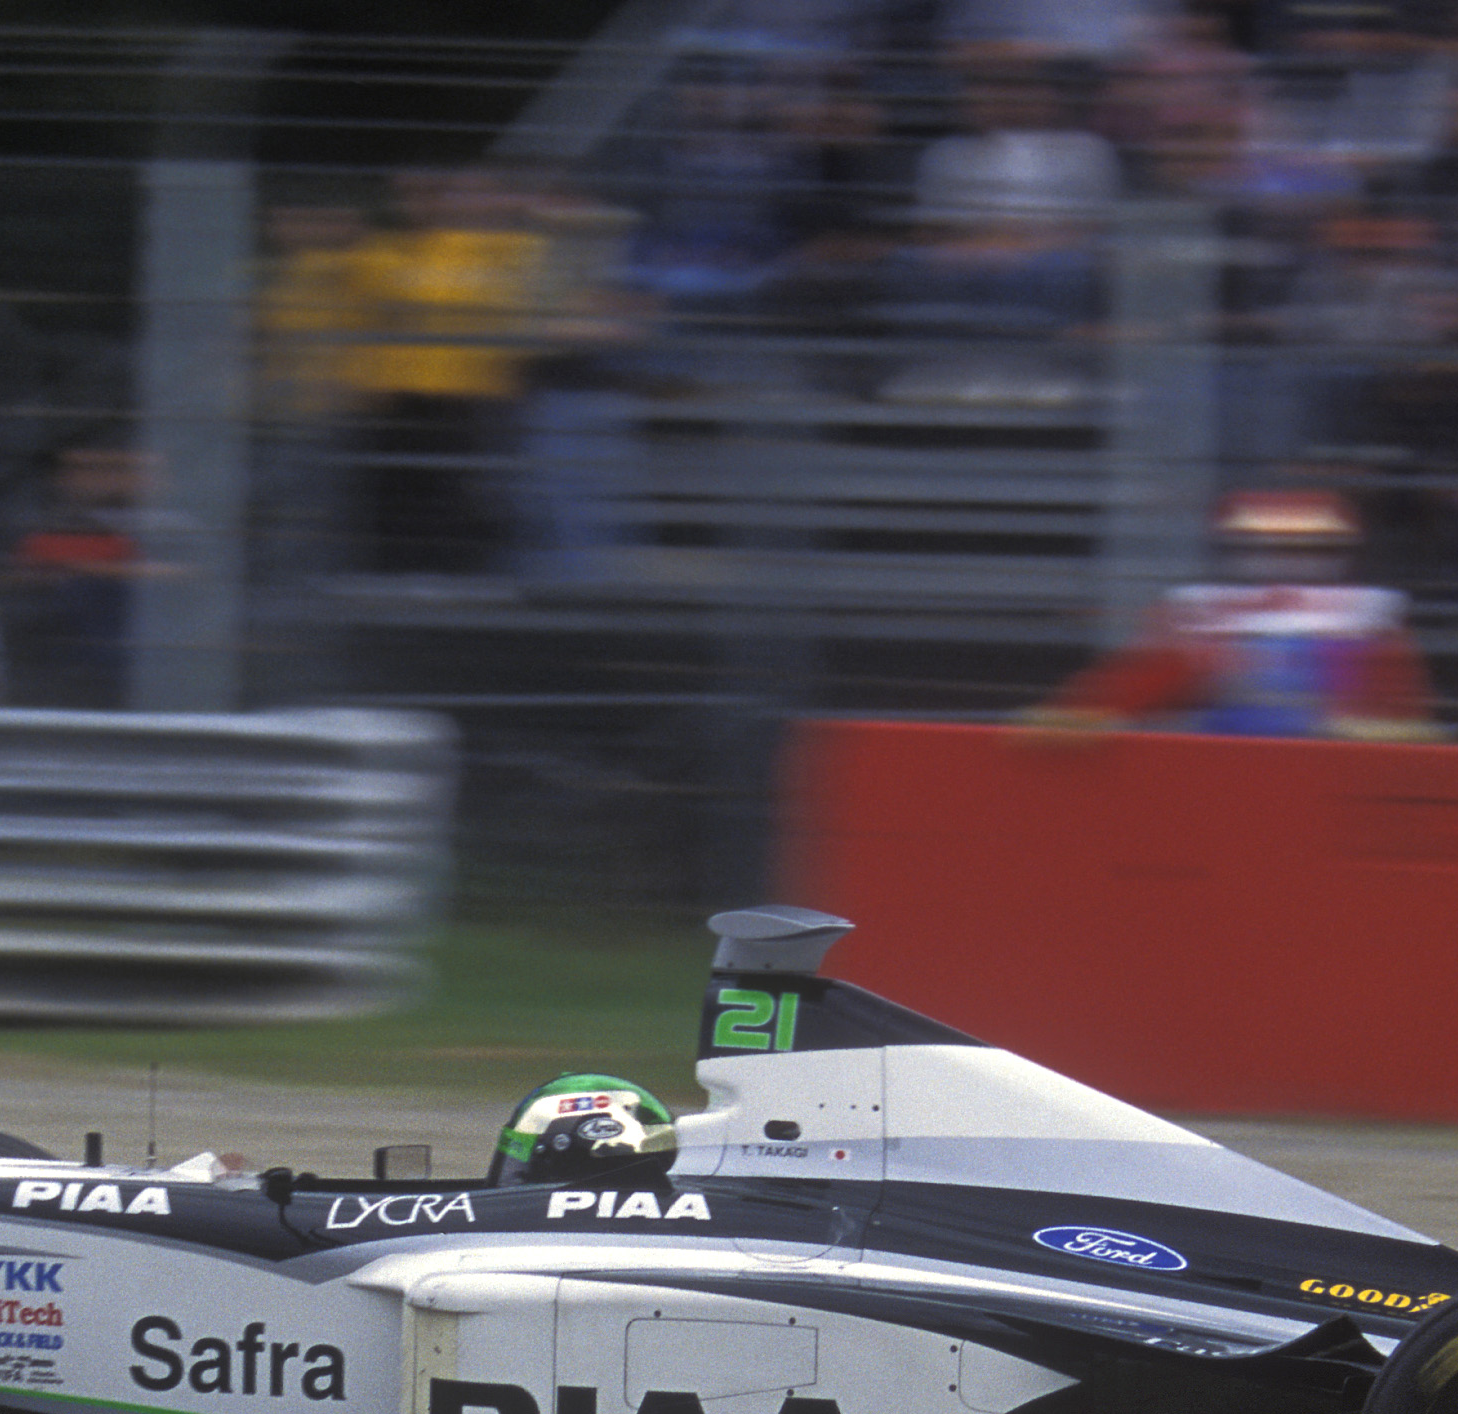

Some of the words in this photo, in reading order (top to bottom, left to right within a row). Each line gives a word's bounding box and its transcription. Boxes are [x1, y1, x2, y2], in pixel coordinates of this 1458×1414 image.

[713, 988, 800, 1052] 21
[12, 1181, 171, 1215] PIAA
[326, 1192, 476, 1229] LYCRA
[546, 1190, 711, 1221] PIAA
[1063, 1232, 1158, 1265] Ford
[129, 1316, 348, 1401] Safra
